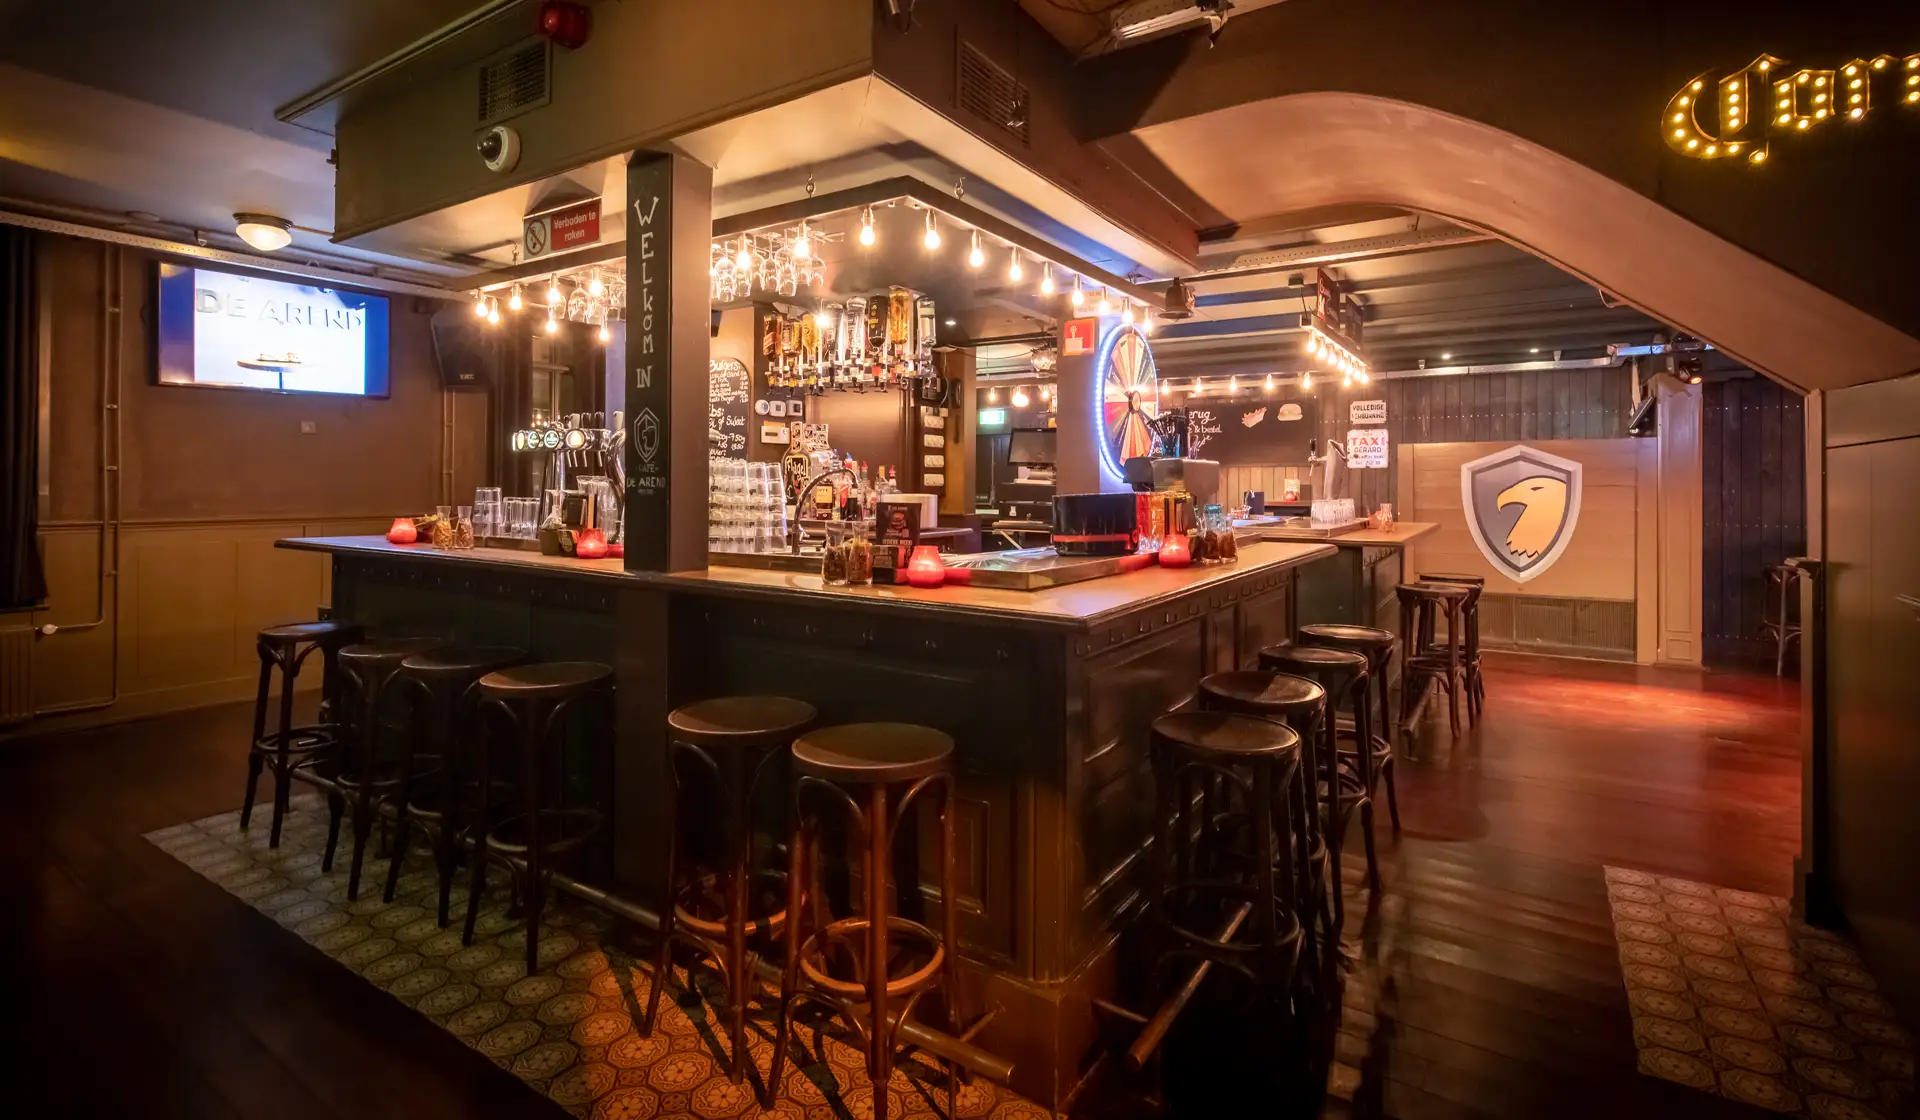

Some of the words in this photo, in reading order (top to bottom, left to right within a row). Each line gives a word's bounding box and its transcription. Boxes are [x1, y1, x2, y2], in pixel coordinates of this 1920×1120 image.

[553, 214, 587, 229] Verboden
[588, 211, 596, 221] te
[564, 229, 585, 241] roken
[195, 288, 247, 318] DE
[259, 299, 362, 331] AREND
[636, 365, 653, 388] IN
[1350, 437, 1385, 446] TAXI
